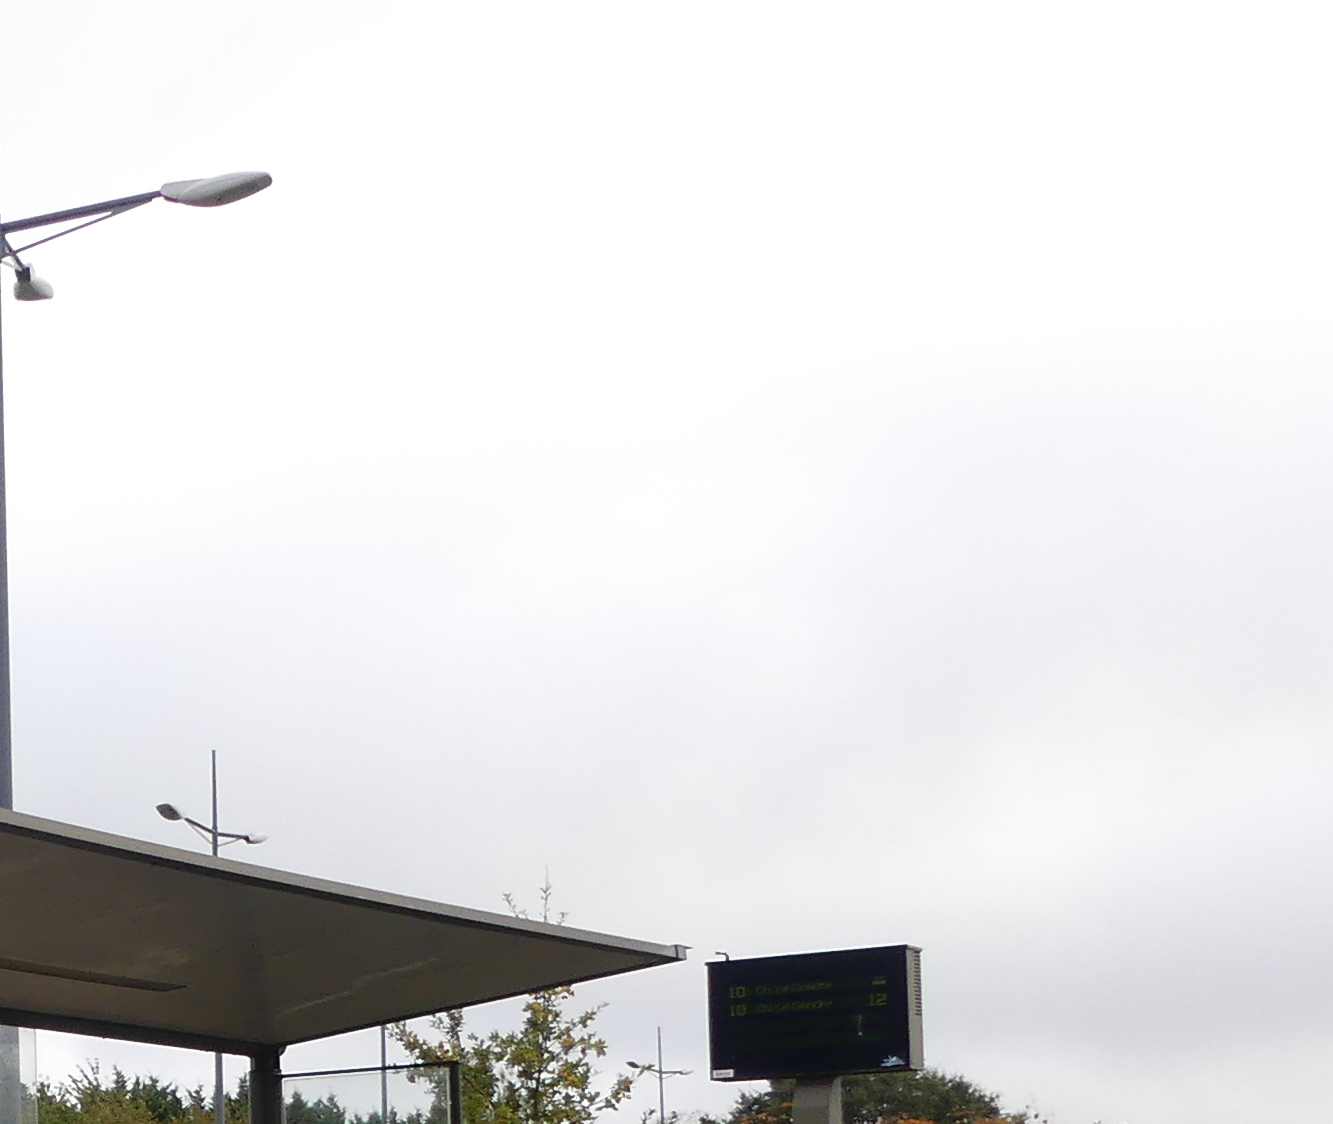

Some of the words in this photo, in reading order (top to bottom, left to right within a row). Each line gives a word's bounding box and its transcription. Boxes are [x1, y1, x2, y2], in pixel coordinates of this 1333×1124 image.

[728, 985, 747, 999] 10
[730, 1003, 747, 1017] 10
[869, 992, 888, 1007] 12
